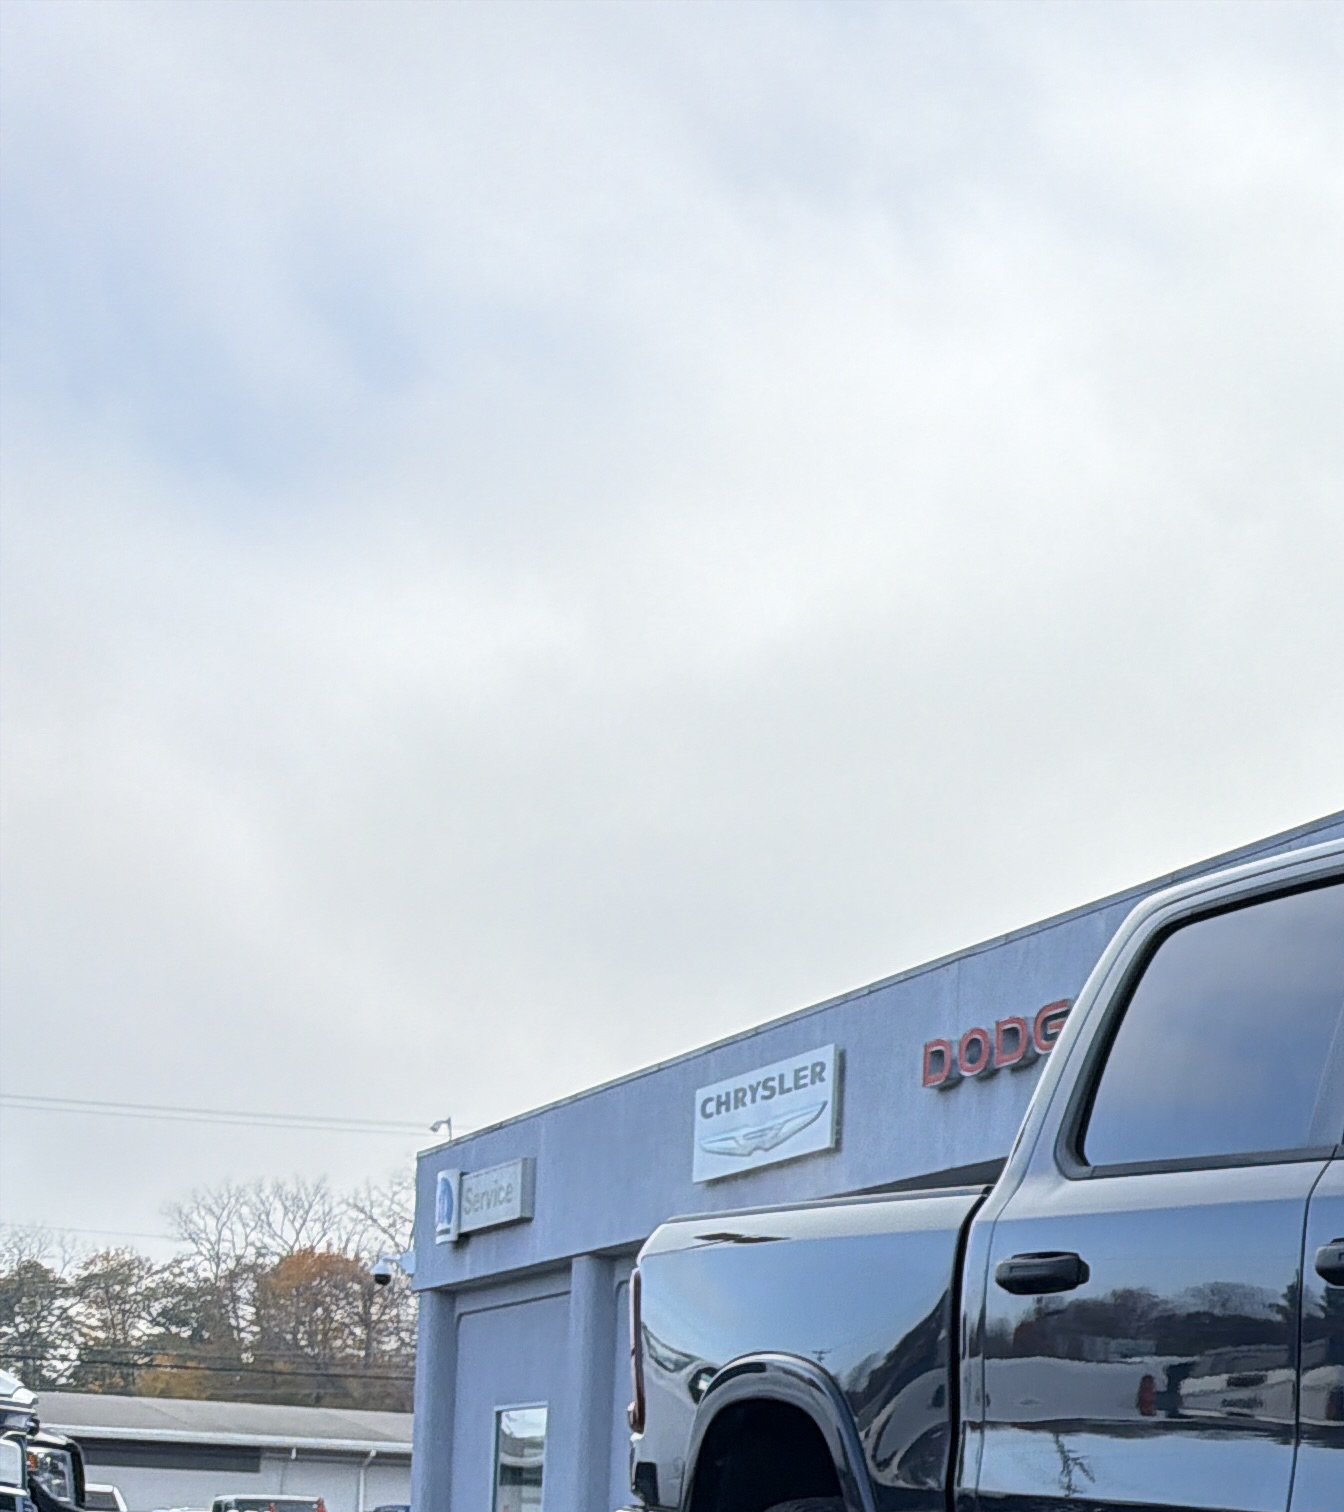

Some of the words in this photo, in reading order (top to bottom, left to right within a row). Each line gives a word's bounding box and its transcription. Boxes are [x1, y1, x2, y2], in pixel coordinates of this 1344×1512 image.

[922, 999, 1072, 1088] DODG
[700, 1061, 827, 1119] CHRYSLER
[463, 1179, 514, 1216] Service
